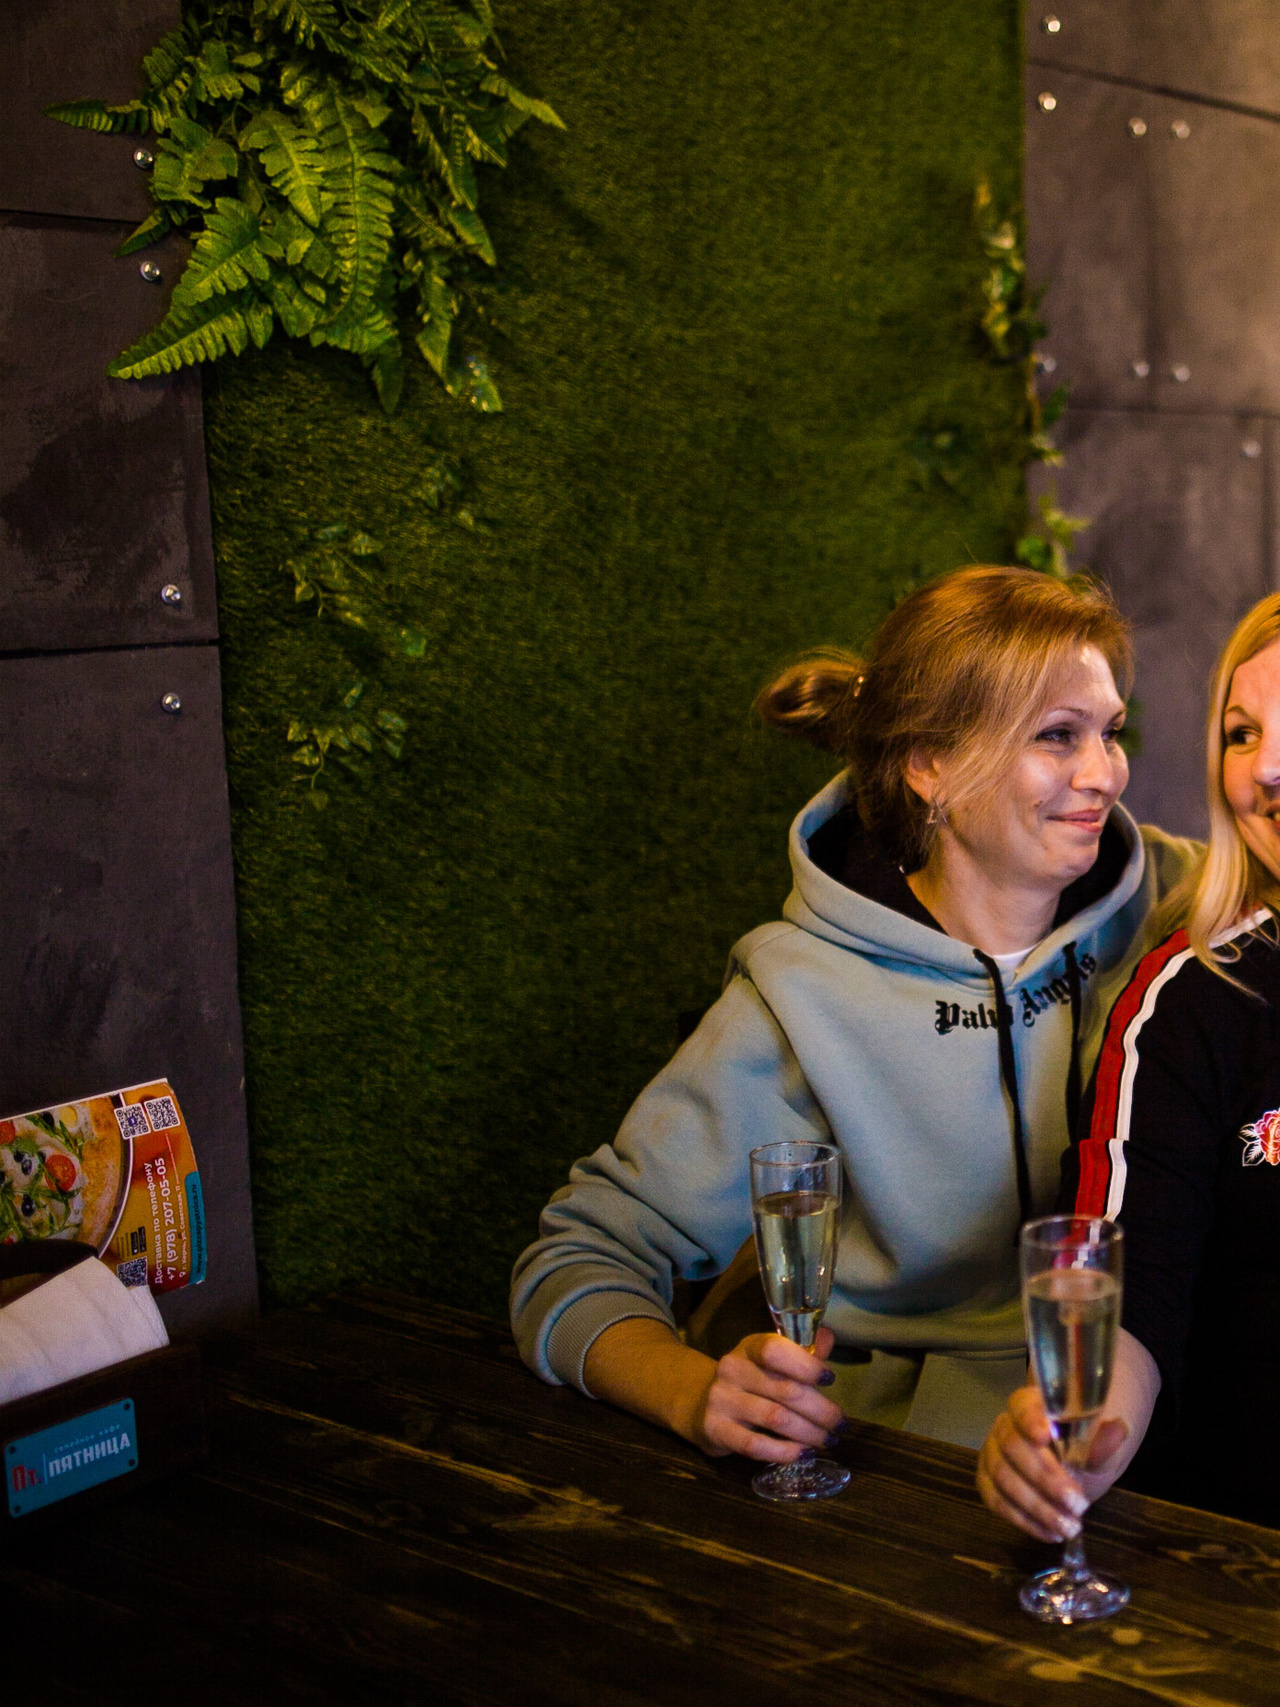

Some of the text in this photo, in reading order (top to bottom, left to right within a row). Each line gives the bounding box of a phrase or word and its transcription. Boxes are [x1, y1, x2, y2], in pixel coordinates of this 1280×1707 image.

[143, 1163, 163, 1283] Доставка по телефону
[154, 1157, 178, 1279] +7 (978) 207-05-05
[48, 1432, 131, 1477] ПЯТНИЦА
